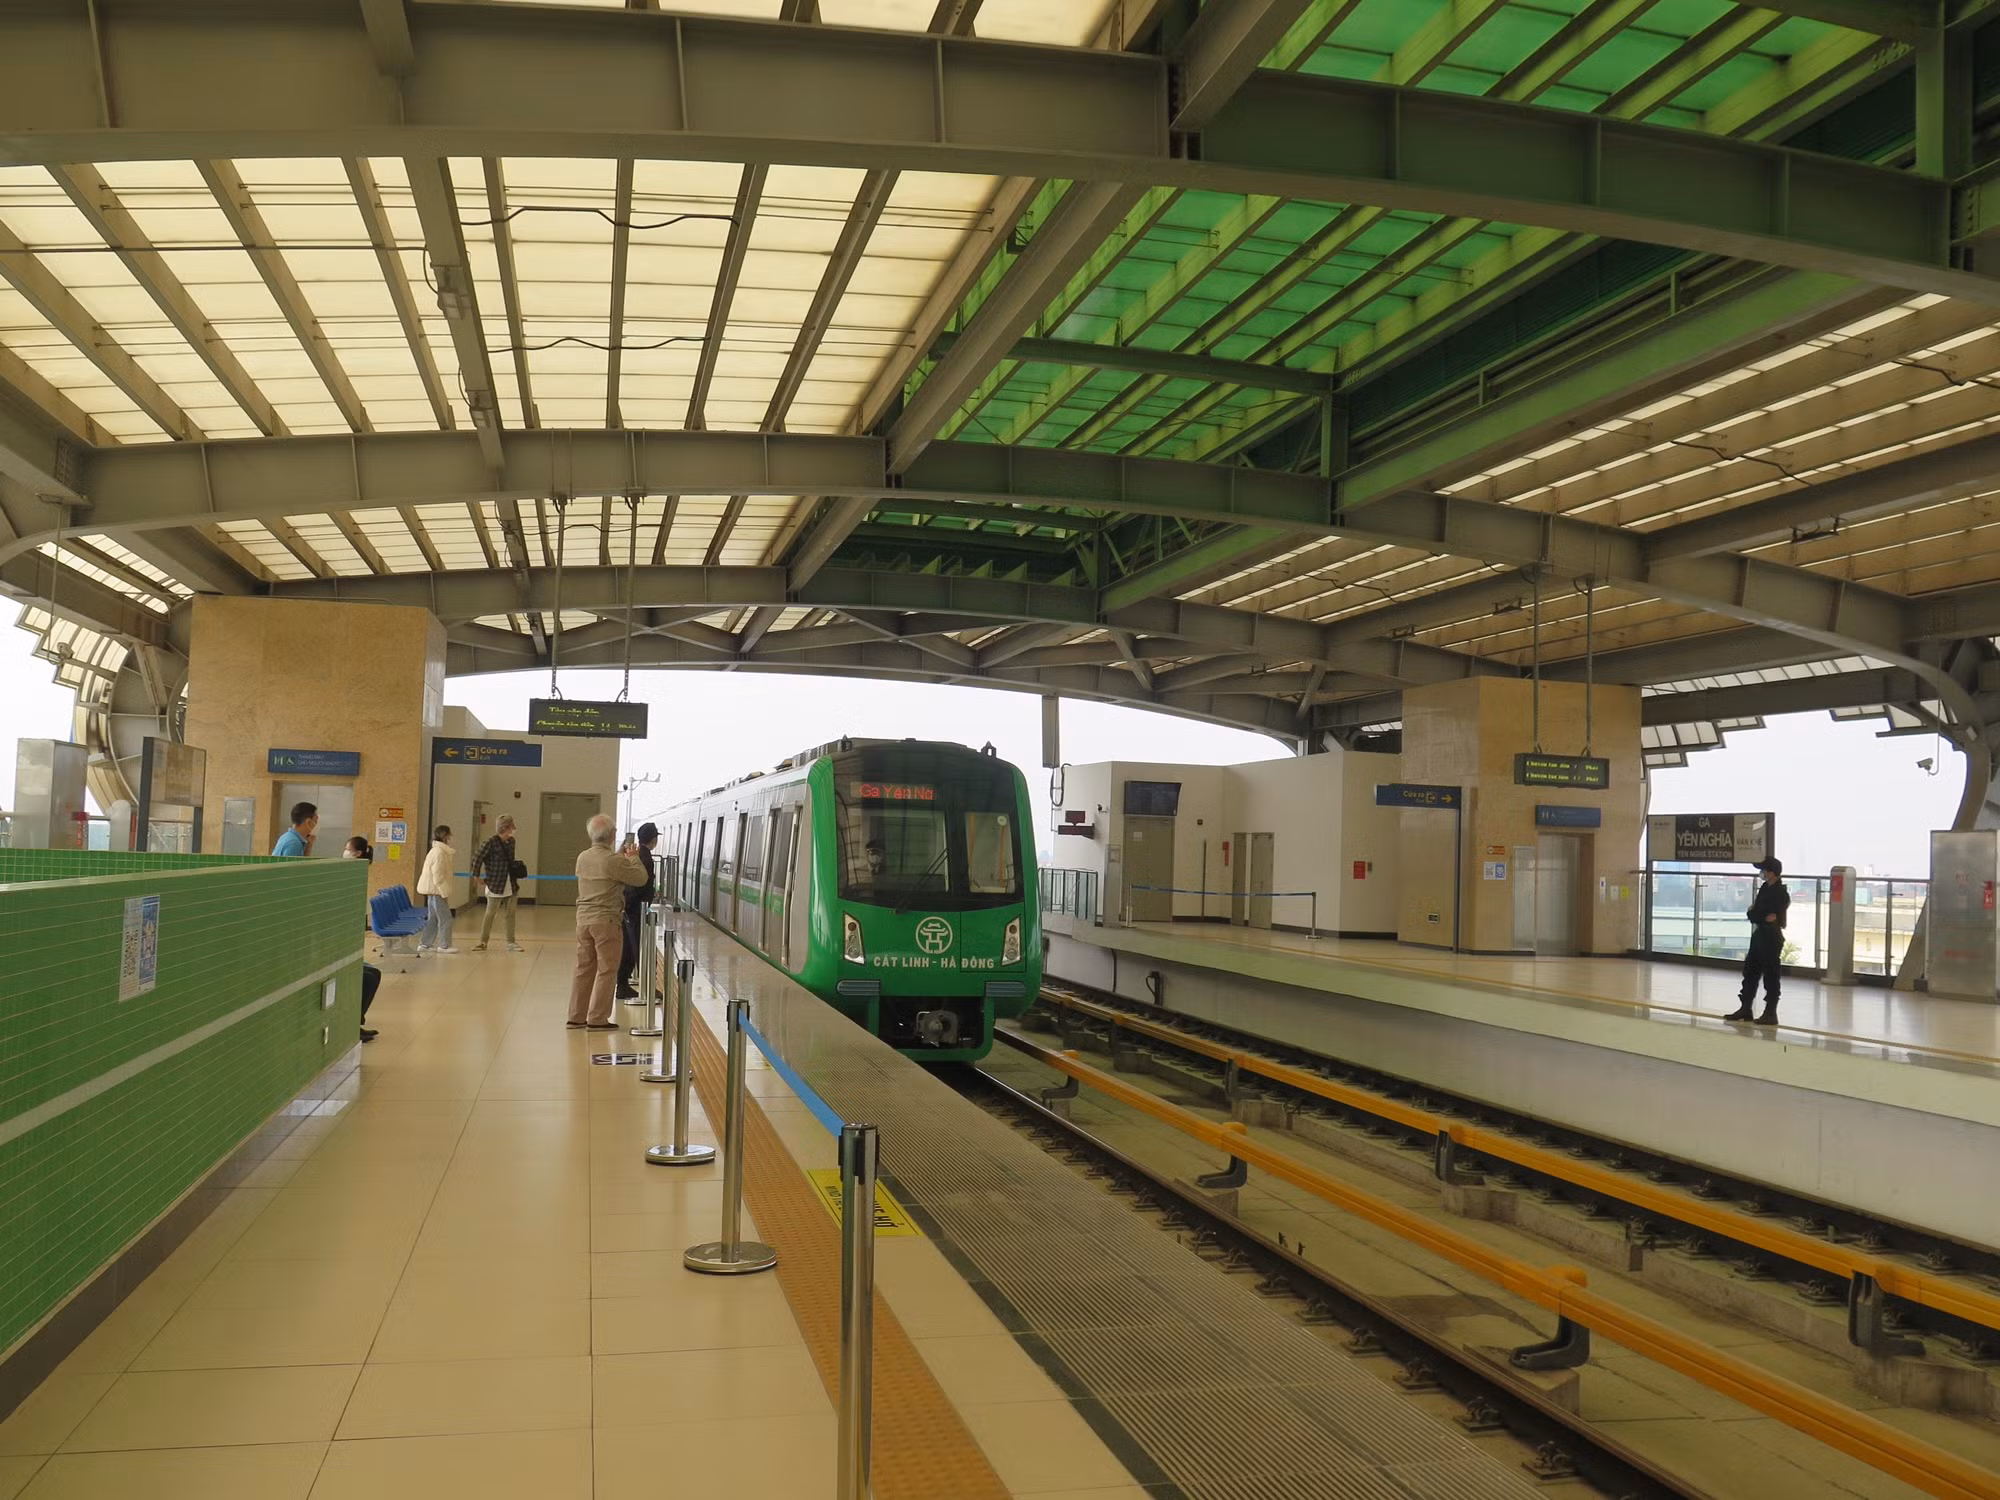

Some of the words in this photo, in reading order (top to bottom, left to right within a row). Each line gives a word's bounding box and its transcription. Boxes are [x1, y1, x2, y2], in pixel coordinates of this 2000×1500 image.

[860, 783, 881, 798] Ga
[1699, 816, 1711, 828] GA
[1677, 830, 1698, 847] YÊN
[1699, 830, 1733, 847] NGHĨA
[873, 954, 898, 968] CÁT
[902, 957, 930, 968] LINH
[941, 955, 957, 968] HÀ
[961, 955, 995, 969] ĐÔNG
